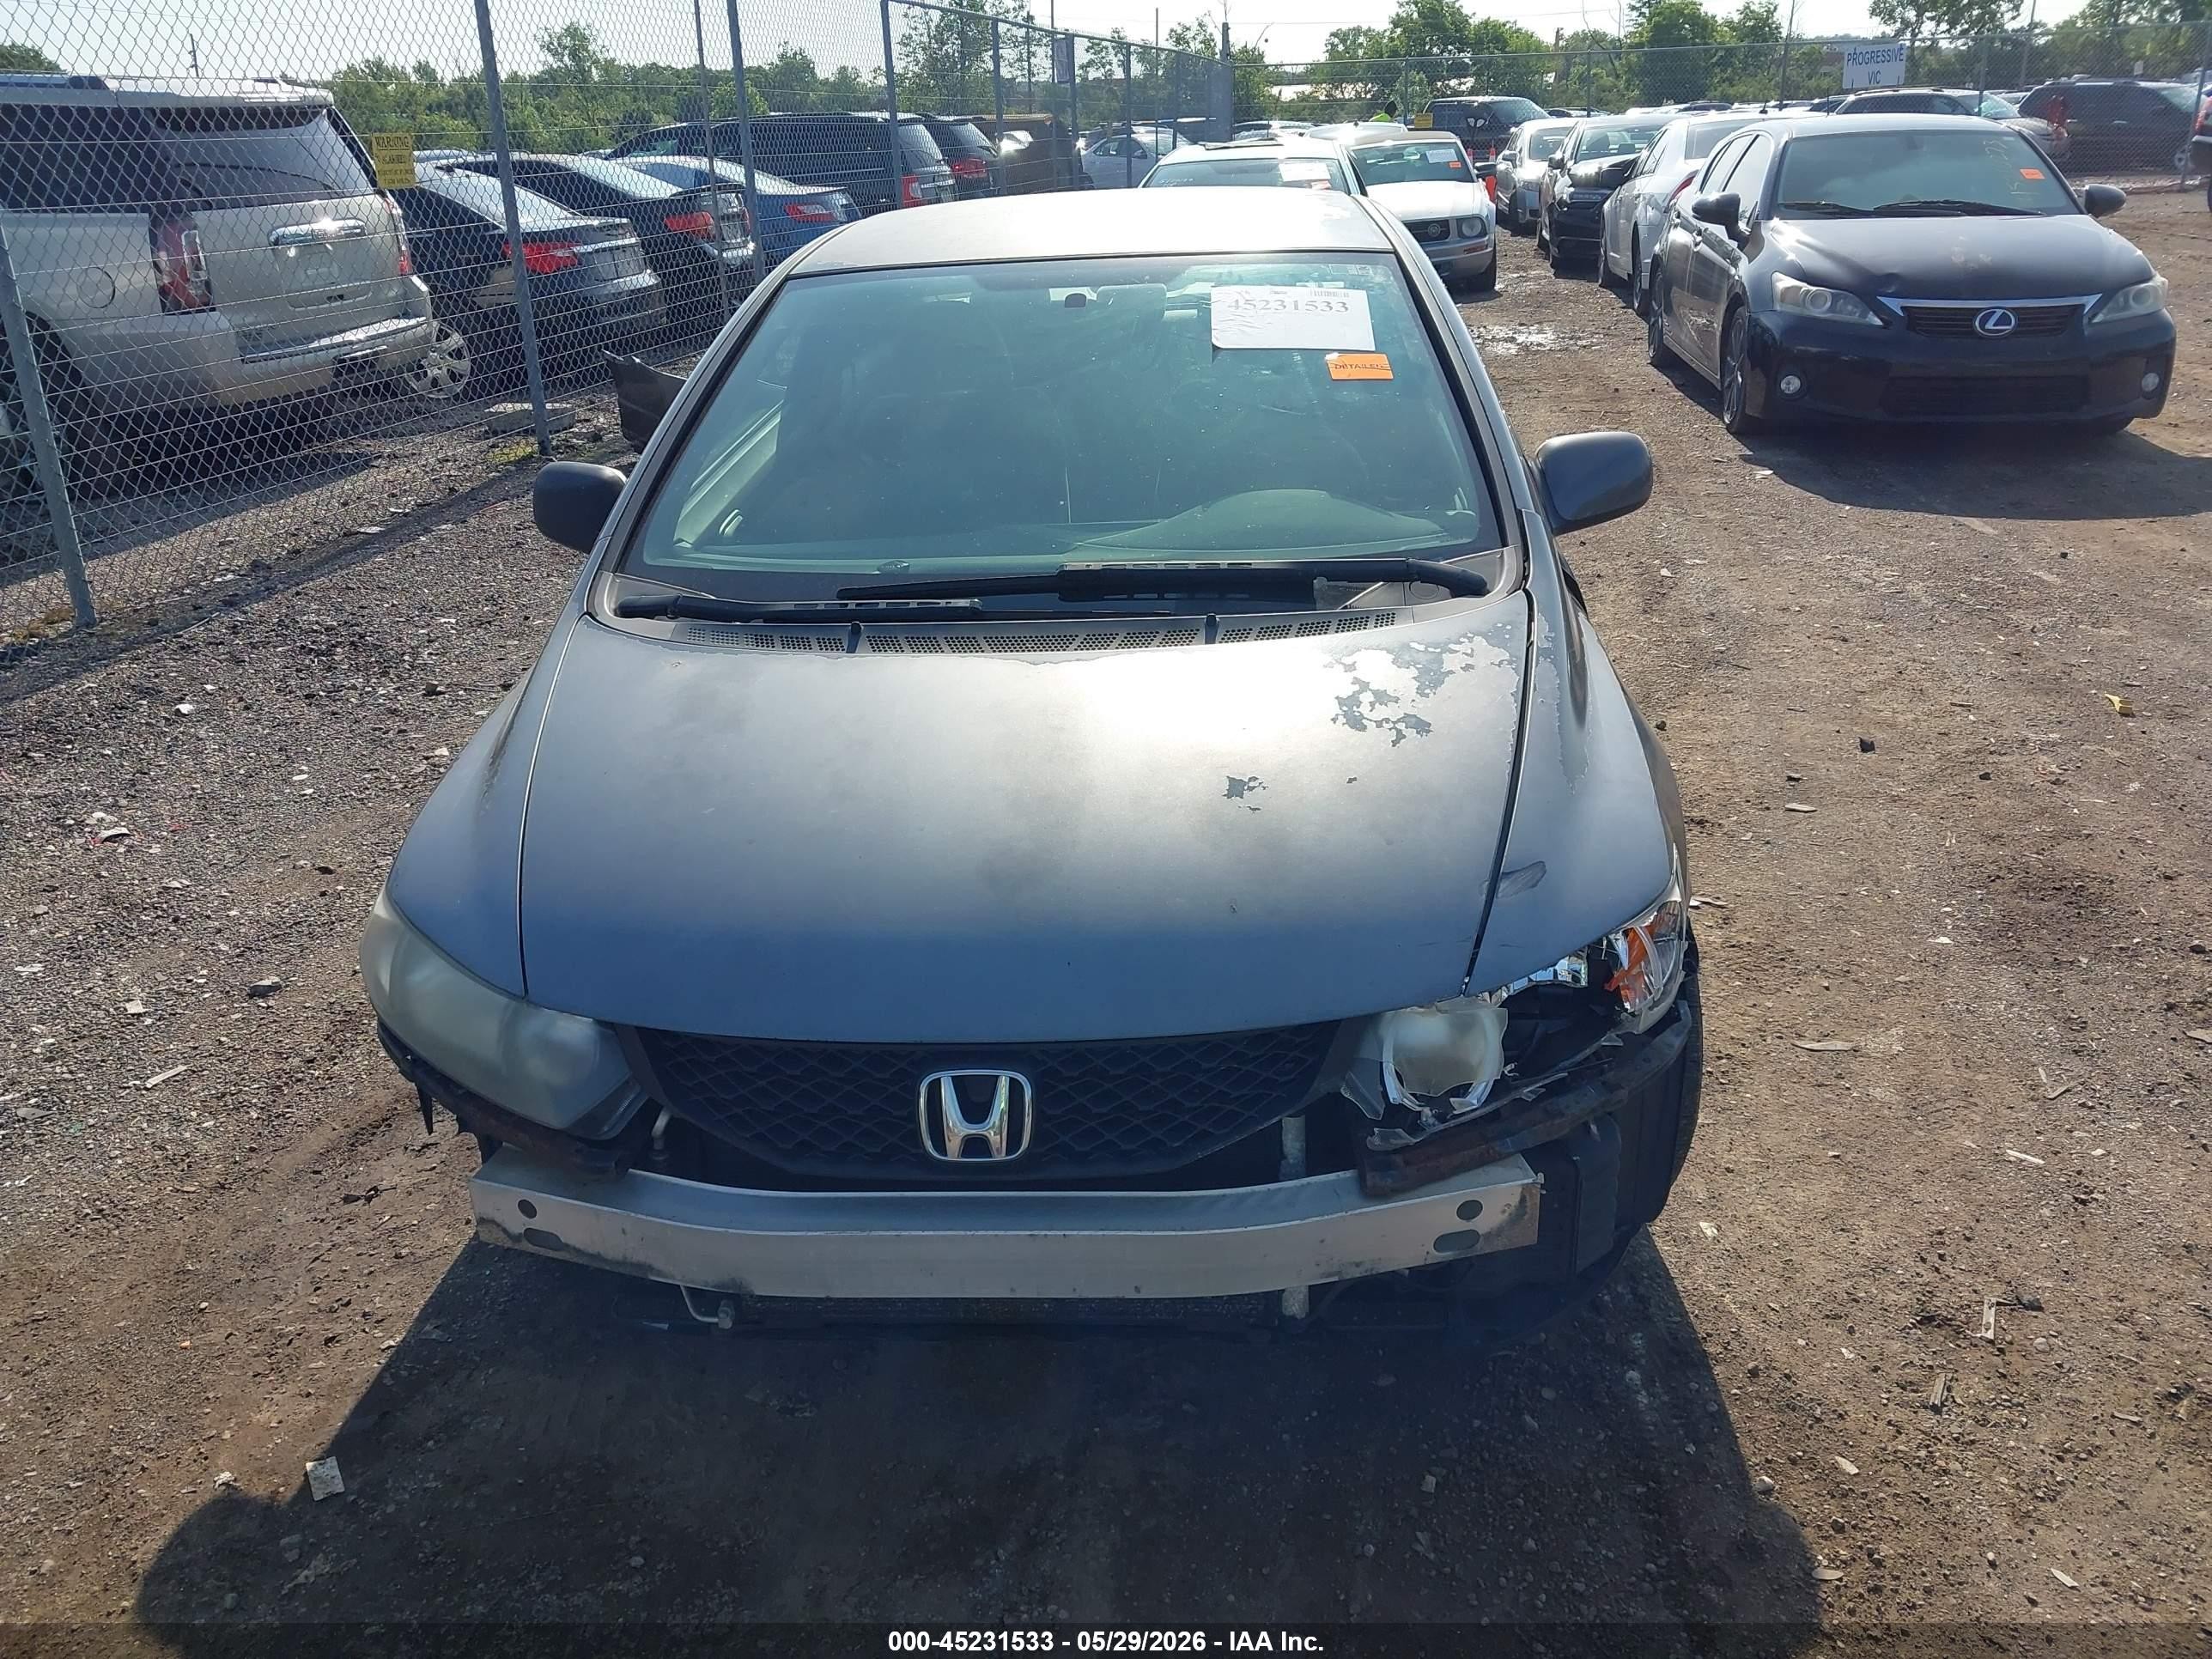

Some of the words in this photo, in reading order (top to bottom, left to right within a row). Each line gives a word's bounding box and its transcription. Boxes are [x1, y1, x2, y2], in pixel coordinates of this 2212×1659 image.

[1847, 48, 1904, 66] PROGRESSIVE
[1868, 70, 1881, 85] VIC
[1228, 299, 1349, 313] 45231533
